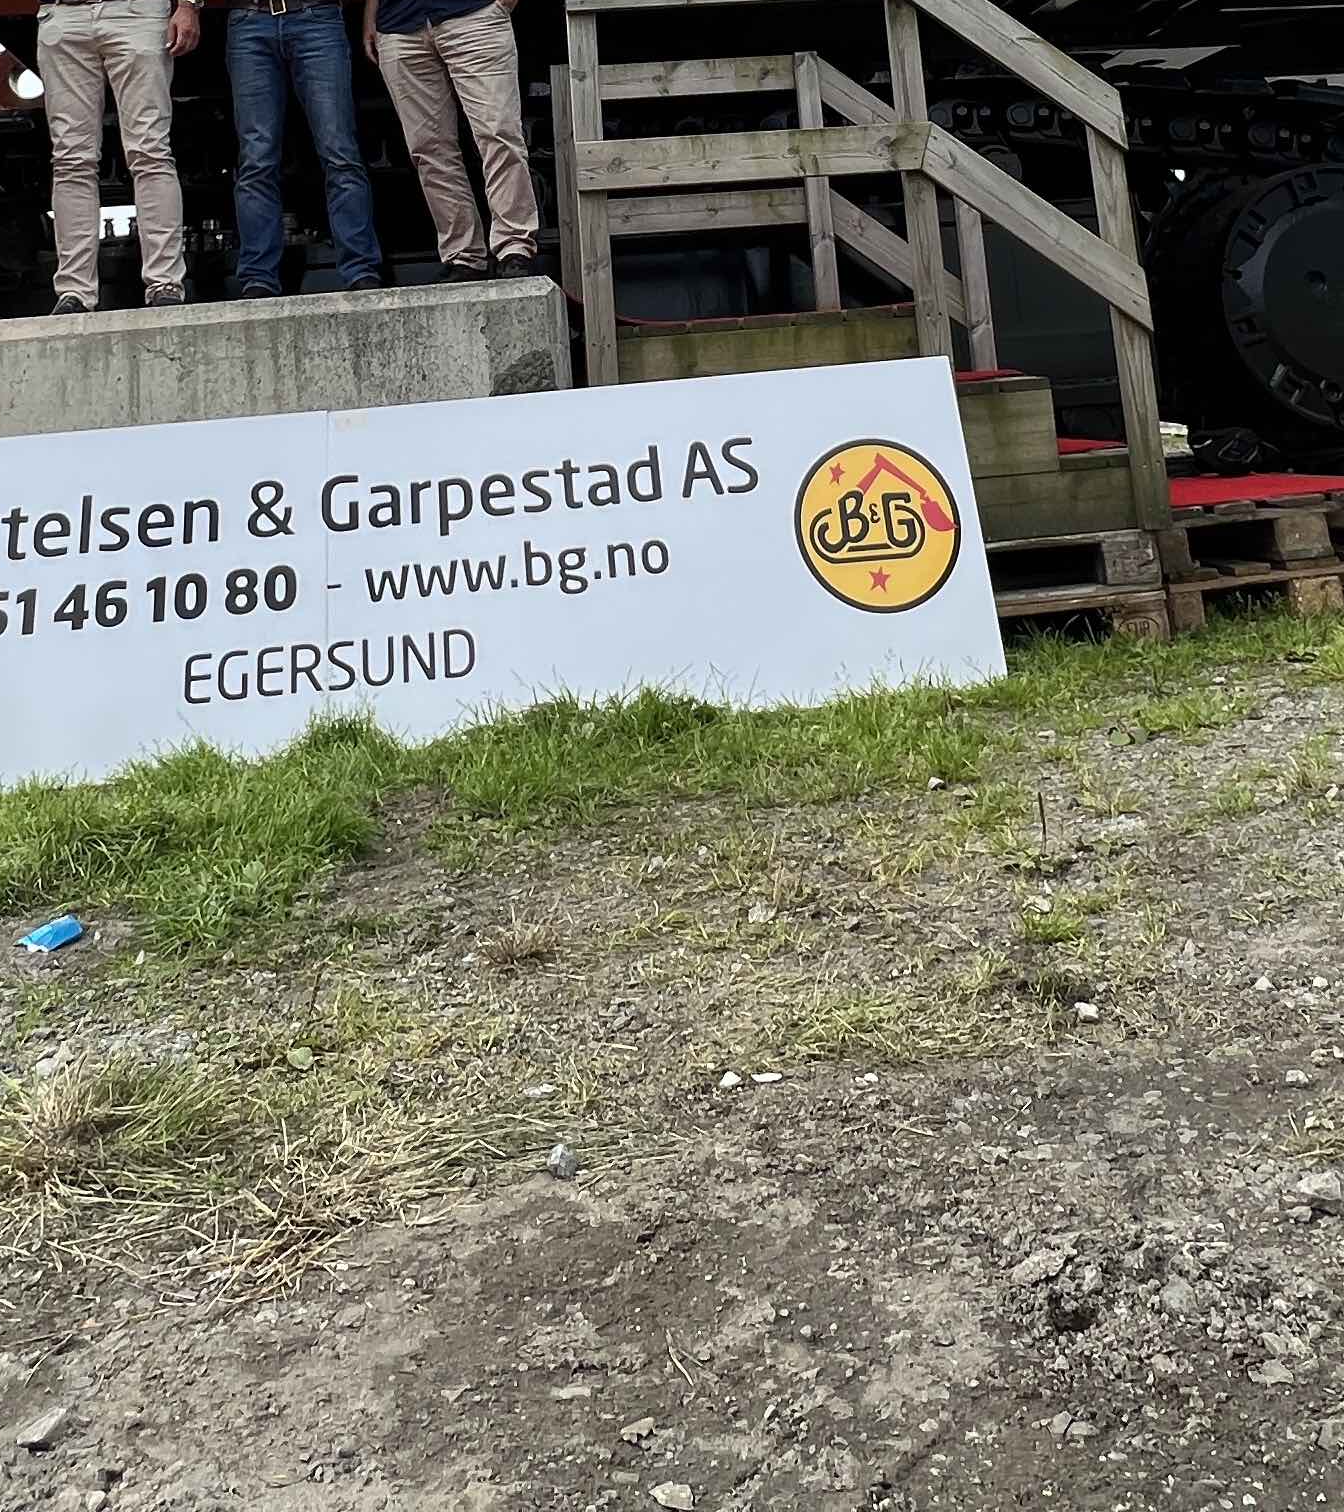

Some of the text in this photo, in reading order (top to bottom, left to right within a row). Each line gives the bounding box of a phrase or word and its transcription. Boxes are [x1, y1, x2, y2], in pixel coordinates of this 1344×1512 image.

[246, 480, 295, 538] &
[322, 445, 662, 536] Garpestad
[682, 436, 759, 499] AS
[54, 581, 128, 632] 46
[146, 573, 209, 624] 10
[224, 565, 298, 617] 80
[364, 539, 670, 603] www.bg.no
[184, 628, 476, 703] EGERSUND
